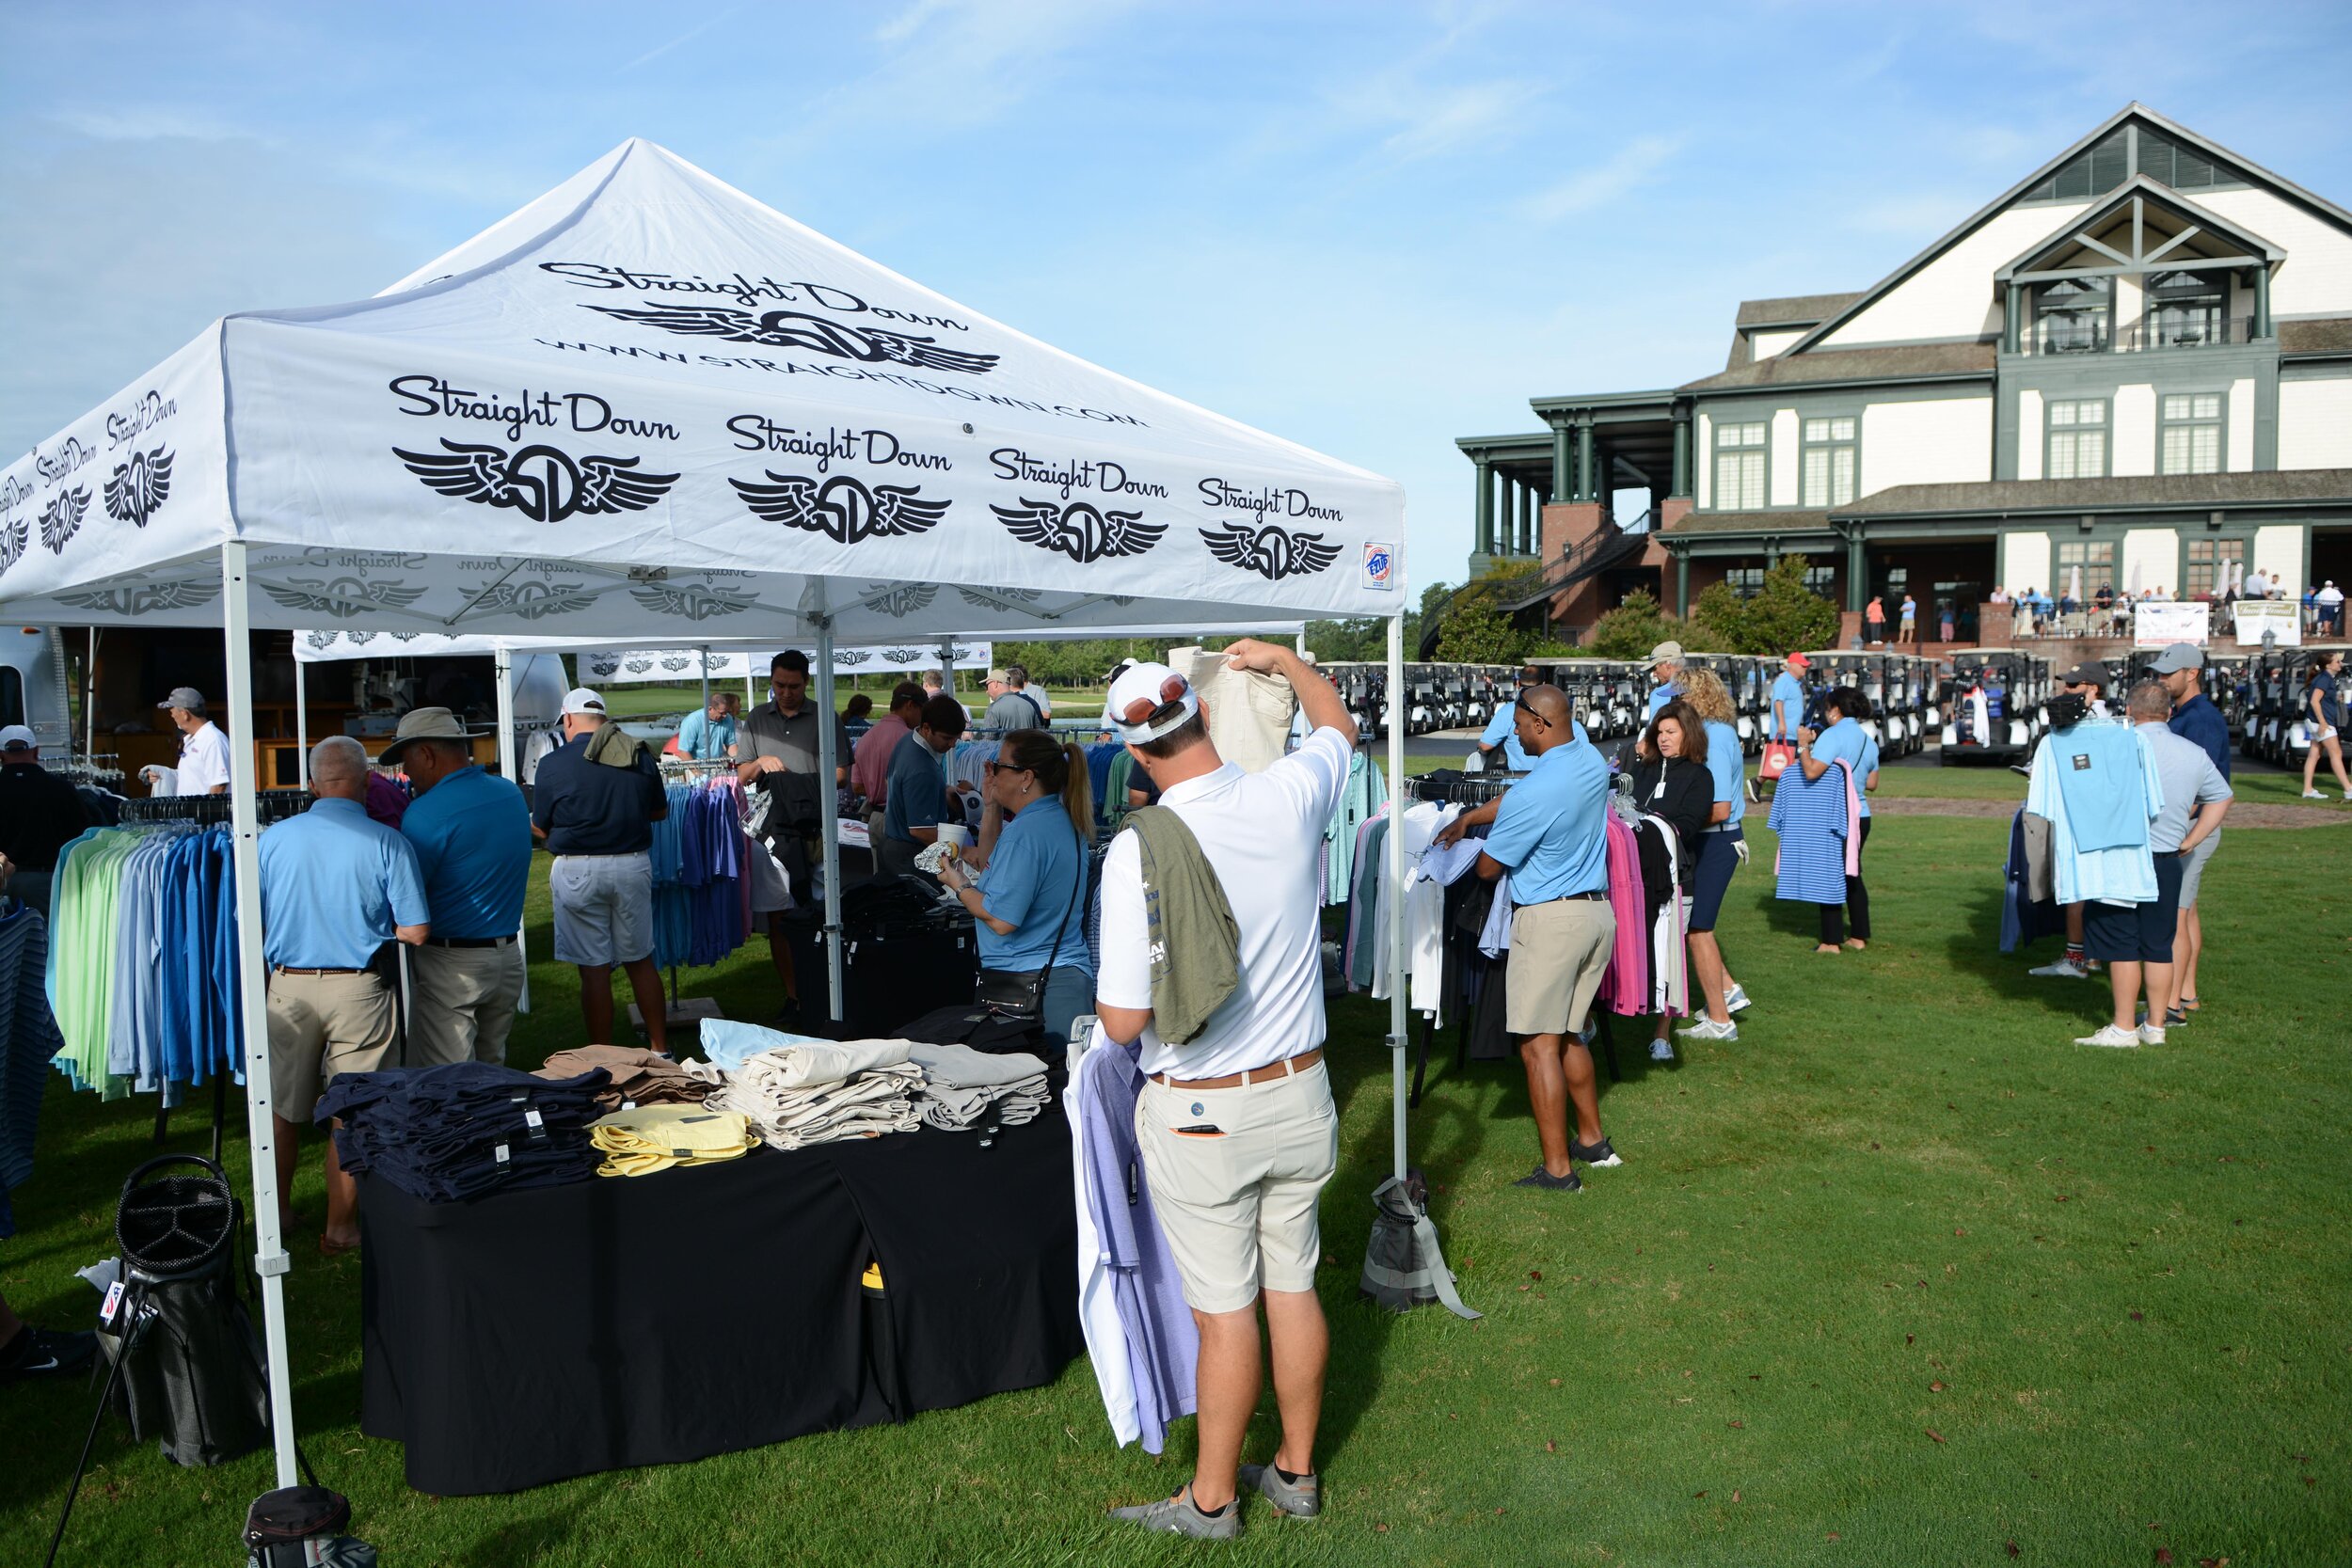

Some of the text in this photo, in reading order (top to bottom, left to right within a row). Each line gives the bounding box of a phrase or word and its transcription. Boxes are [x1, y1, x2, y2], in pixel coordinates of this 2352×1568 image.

[539, 262, 969, 331] Straight Down
[106, 389, 178, 454] Straight Down
[389, 374, 680, 442] Straight Down
[726, 414, 952, 474] Straight Down
[989, 448, 1169, 500] Straight Down
[1198, 478, 1344, 524] Straight Down
